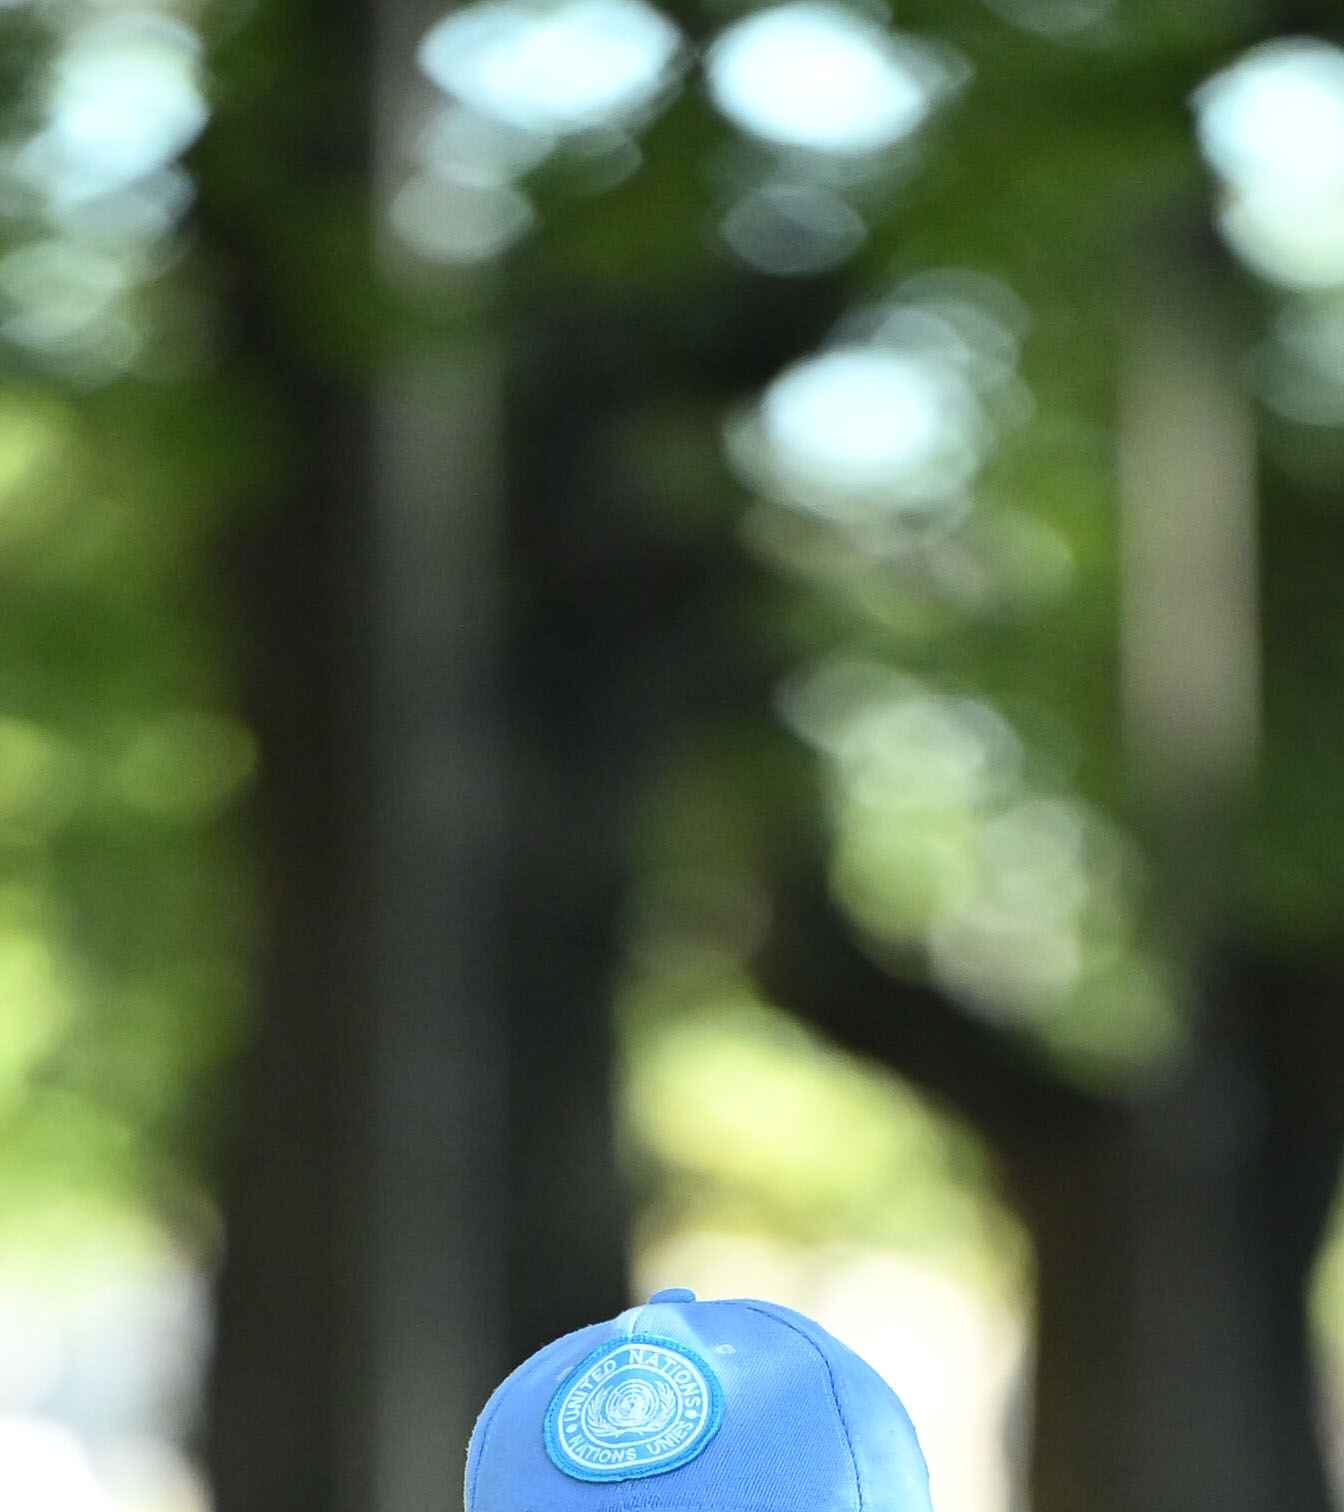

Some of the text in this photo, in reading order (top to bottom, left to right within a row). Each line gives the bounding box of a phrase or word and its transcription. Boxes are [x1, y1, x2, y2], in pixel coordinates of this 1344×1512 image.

[566, 1349, 702, 1422] UNITED NATIONS
[569, 1431, 637, 1463] NATIONS
